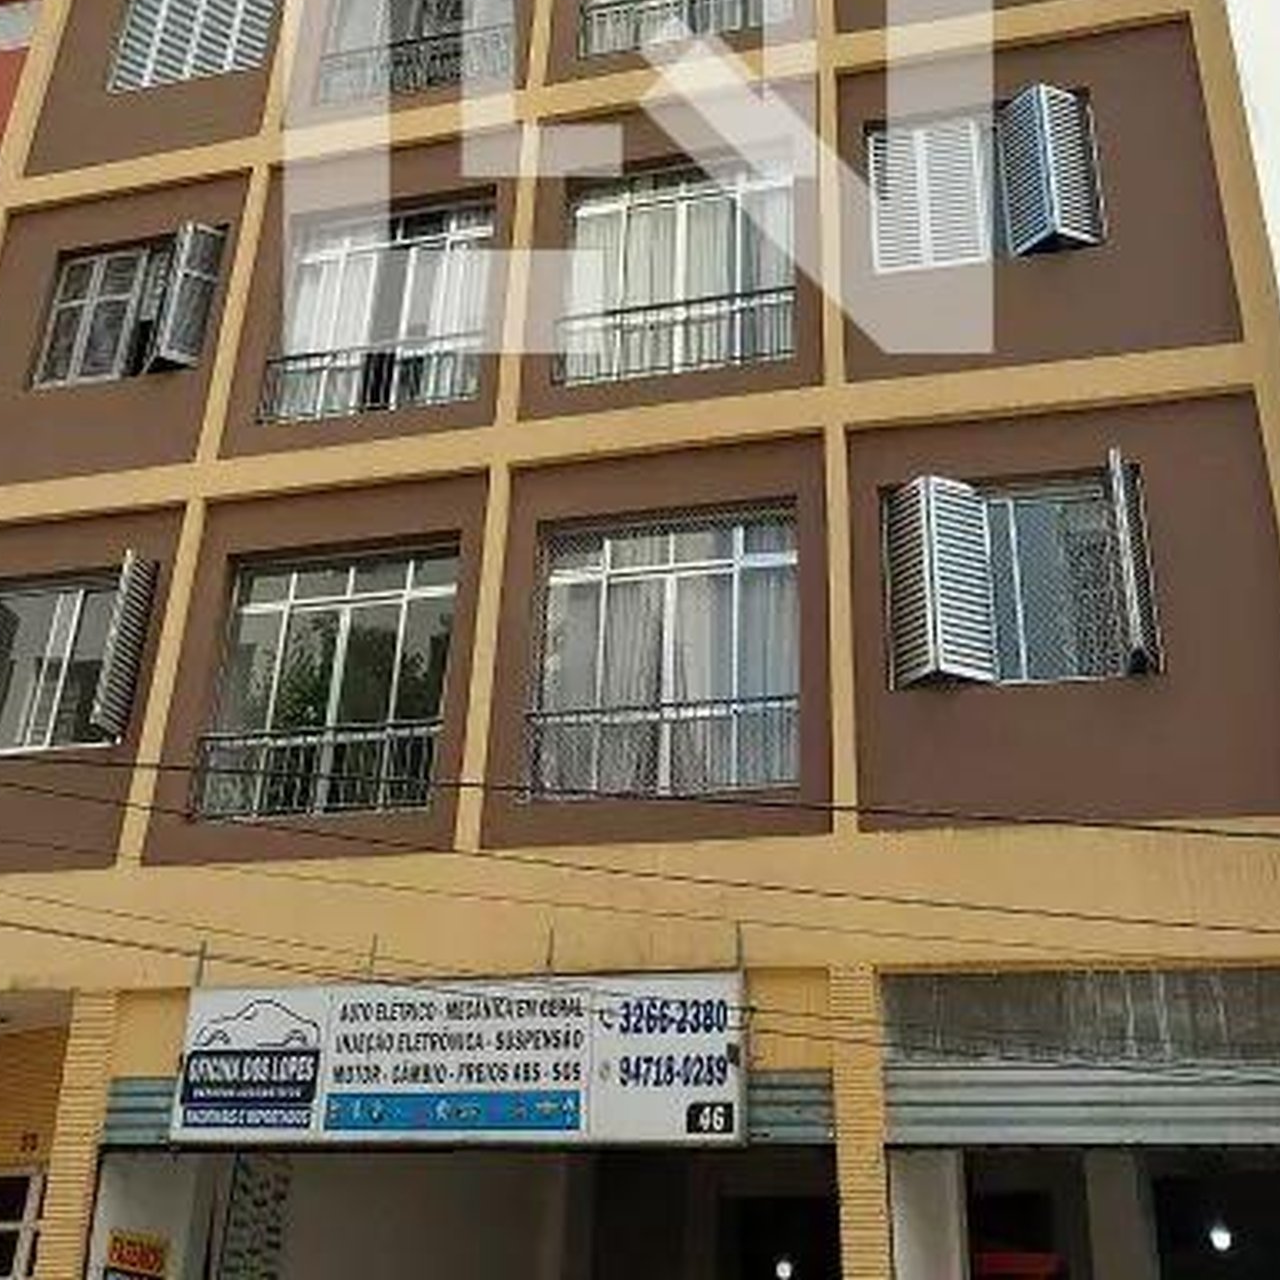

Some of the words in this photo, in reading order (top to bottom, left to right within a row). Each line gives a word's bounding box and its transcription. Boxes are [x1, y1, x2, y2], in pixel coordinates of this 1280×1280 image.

[540, 997, 586, 1018] GERAL
[619, 998, 728, 1034] 3266-2380
[272, 1055, 315, 1081] LOPES
[332, 1065, 381, 1084] MOTOR
[699, 1105, 725, 1131] 46
